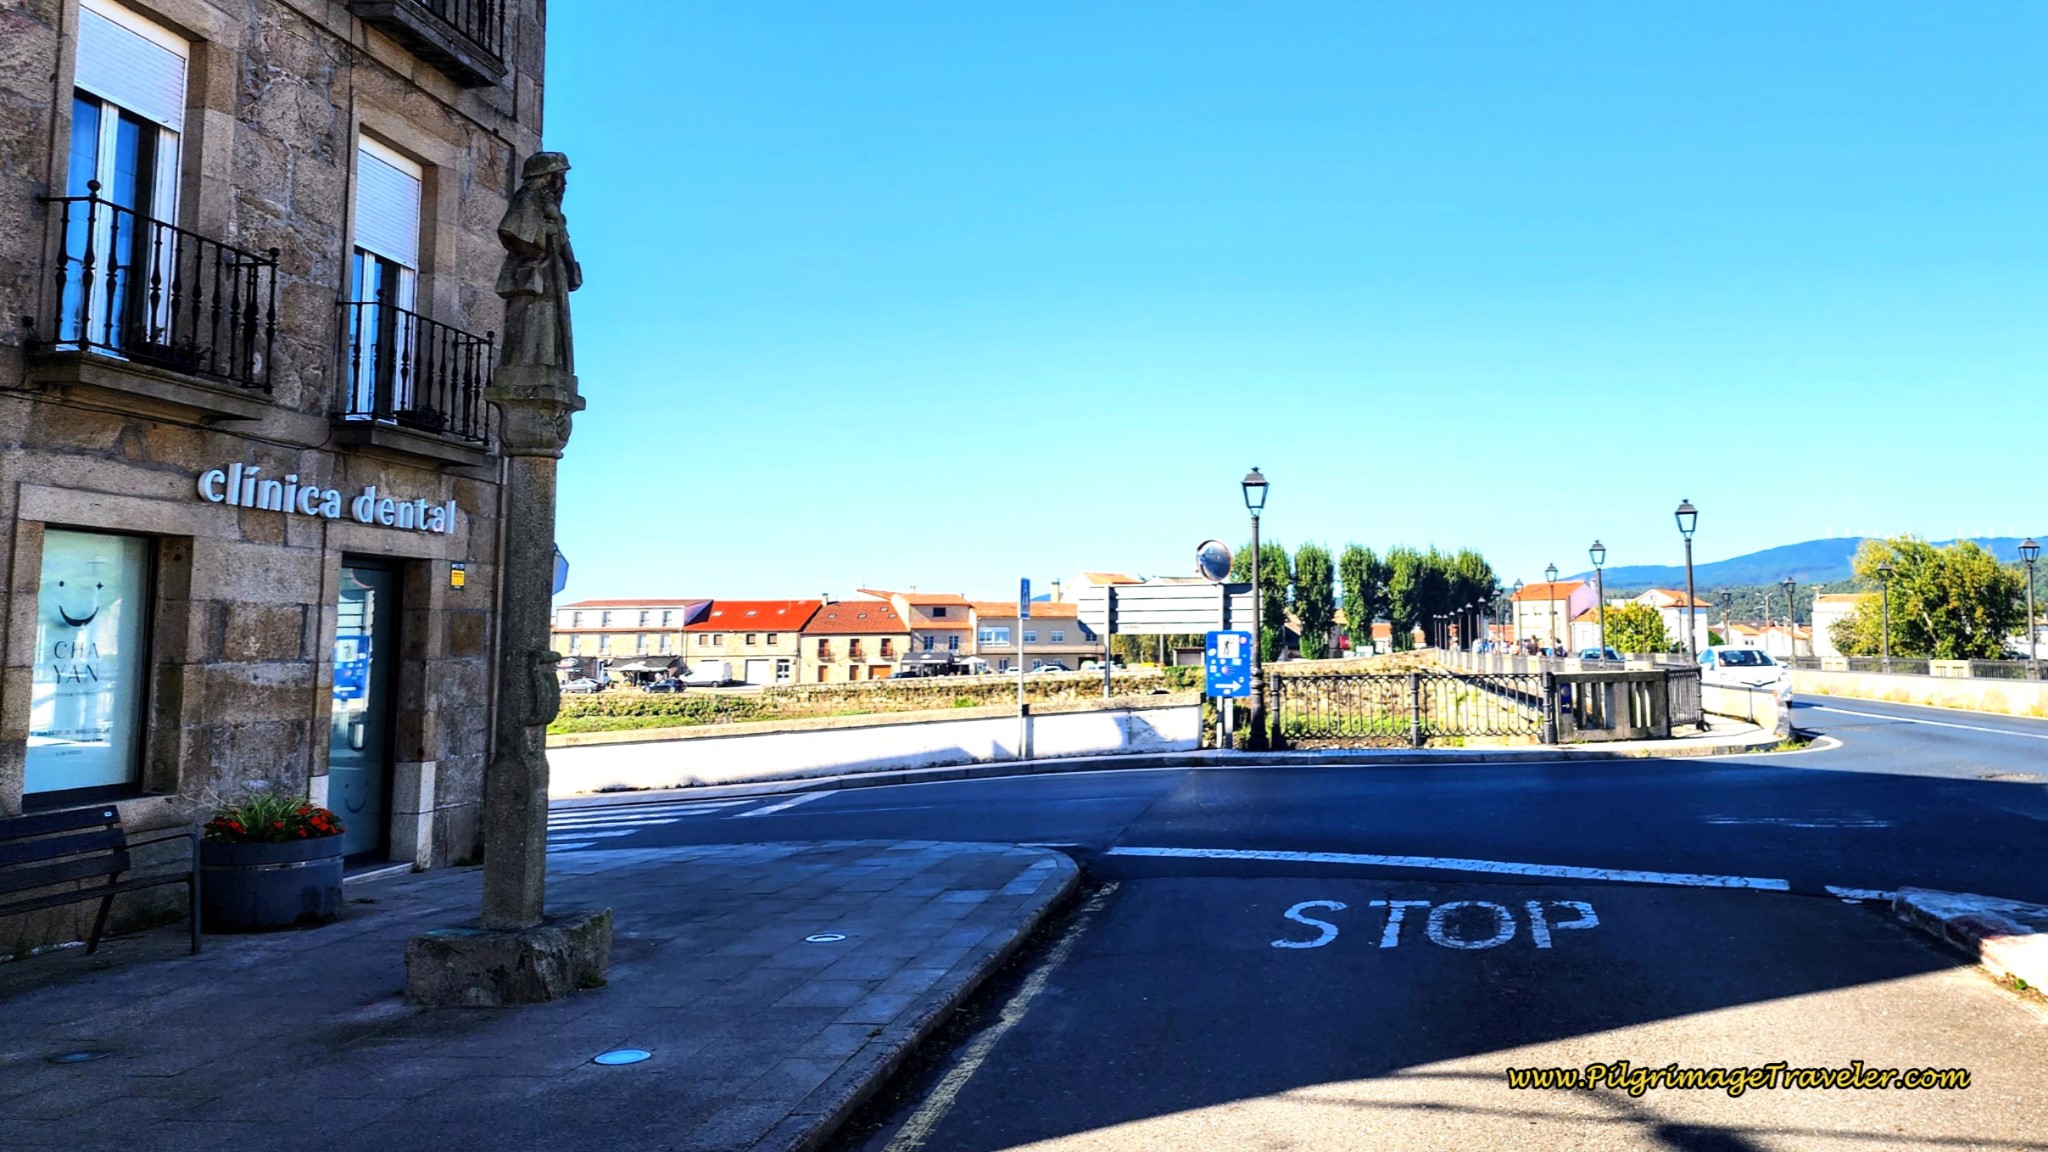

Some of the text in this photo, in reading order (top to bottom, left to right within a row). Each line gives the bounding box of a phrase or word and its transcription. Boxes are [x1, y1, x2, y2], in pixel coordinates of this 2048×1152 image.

[198, 462, 456, 534] clínica dental
[54, 640, 99, 659] CHA
[53, 664, 99, 684] YAN
[1271, 900, 1599, 949] STOP
